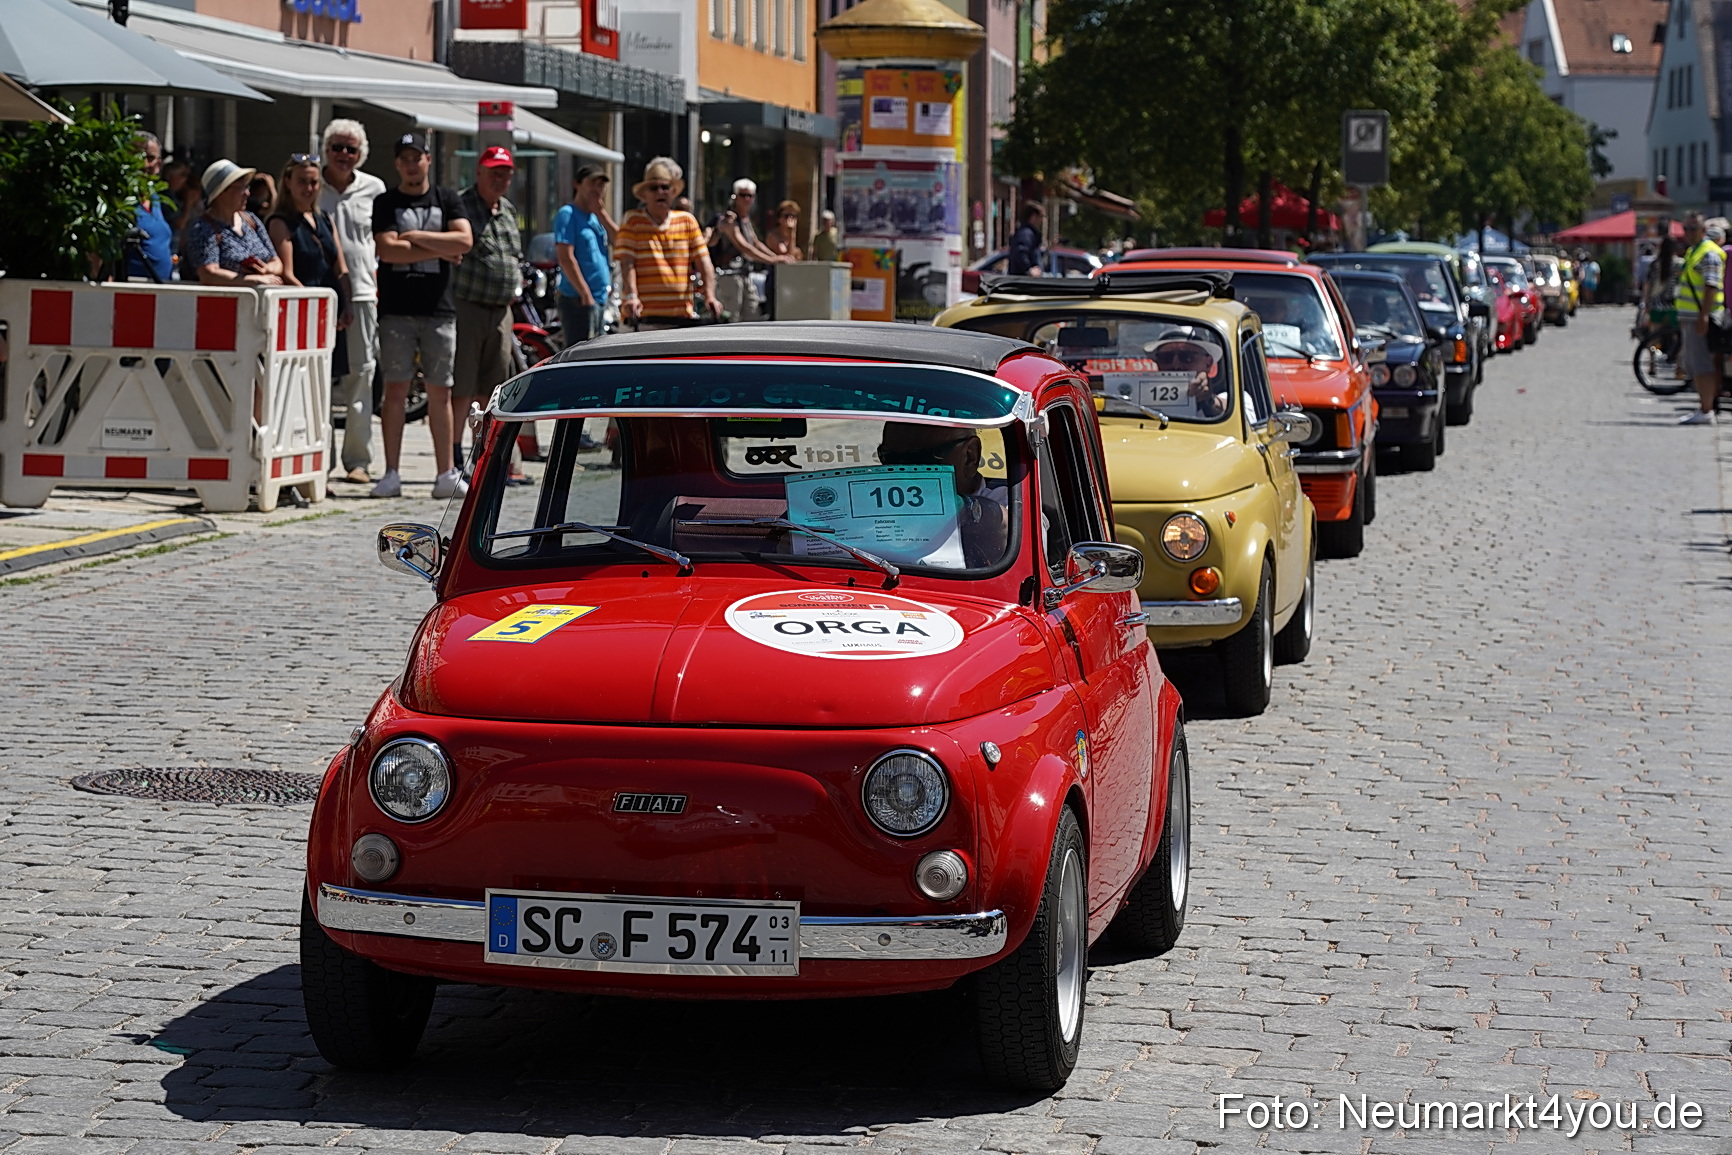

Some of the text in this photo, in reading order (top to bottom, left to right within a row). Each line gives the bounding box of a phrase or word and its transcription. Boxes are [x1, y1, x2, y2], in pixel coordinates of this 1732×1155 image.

[1150, 386, 1180, 401] 123
[870, 486, 925, 508] 103
[495, 620, 543, 636] 5
[773, 620, 931, 638] ORGA
[619, 796, 682, 811] FIAT
[769, 916, 790, 930] 03
[498, 934, 509, 948] D
[521, 906, 584, 954] SC
[622, 910, 654, 958] F
[667, 912, 761, 962] 574
[769, 949, 789, 963] 11
